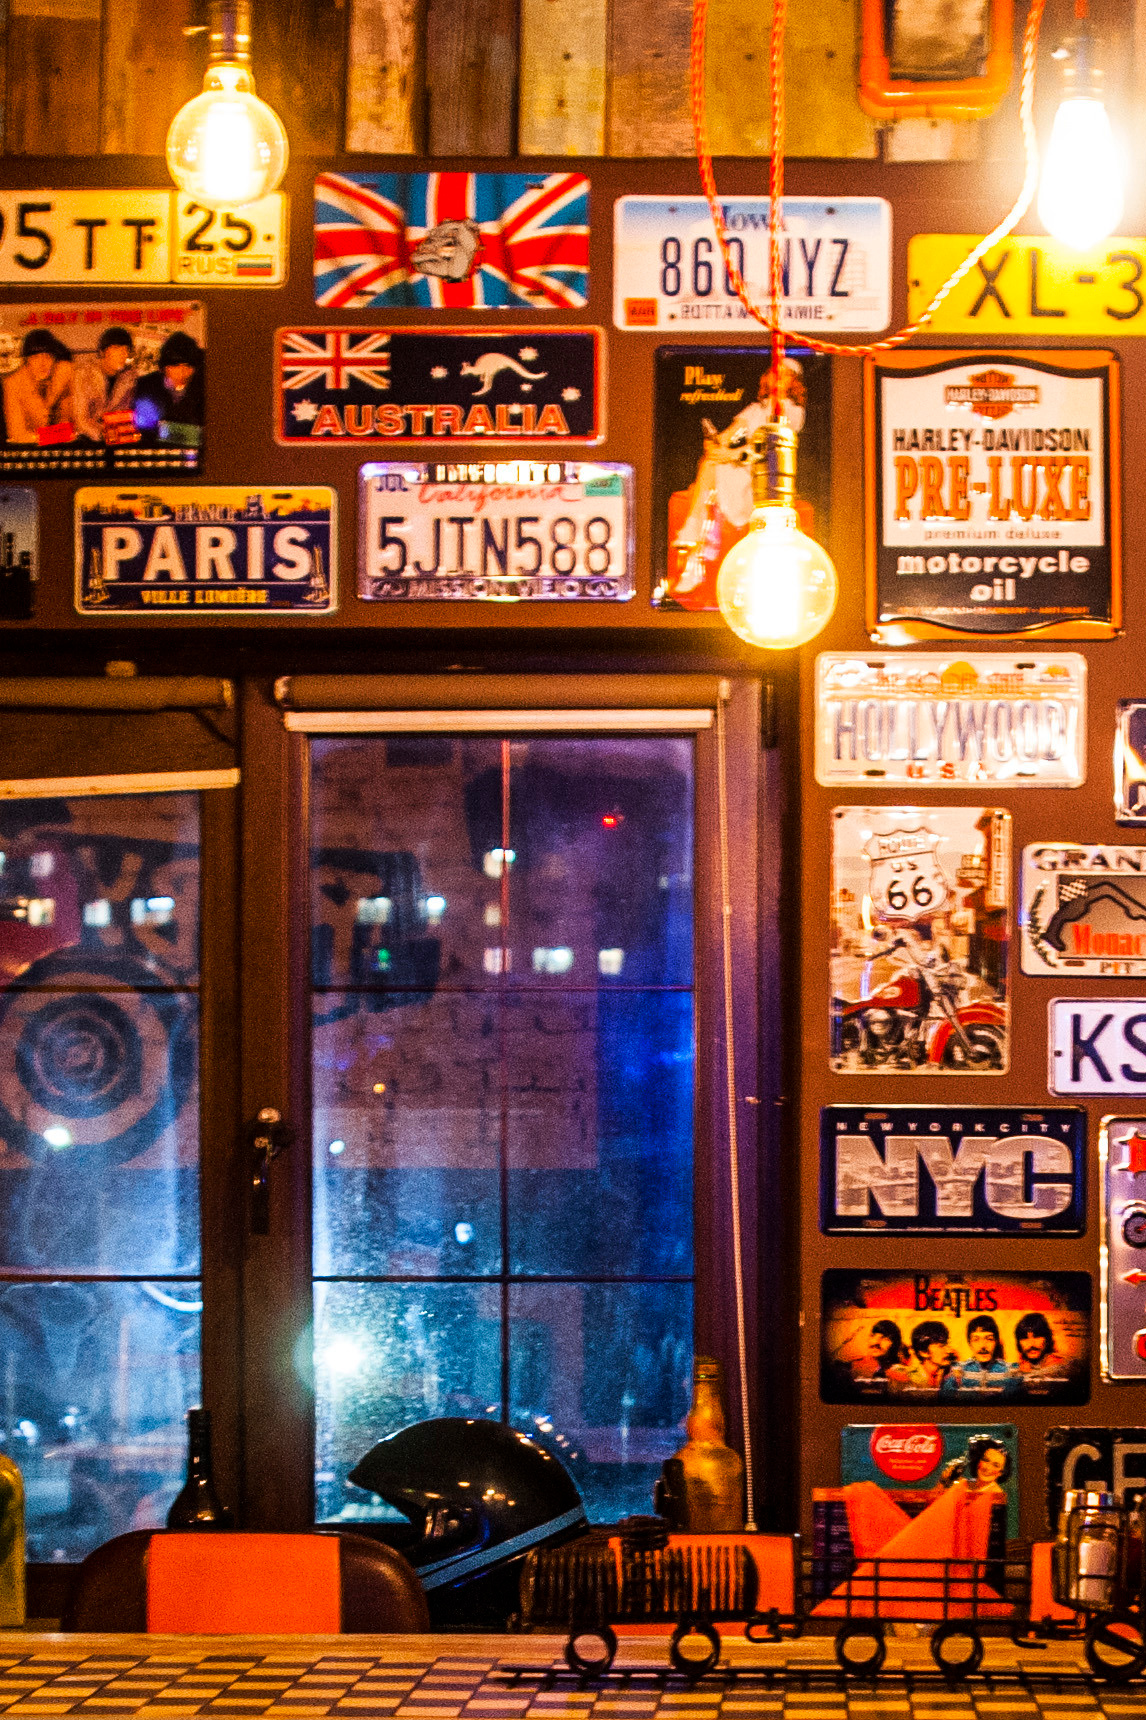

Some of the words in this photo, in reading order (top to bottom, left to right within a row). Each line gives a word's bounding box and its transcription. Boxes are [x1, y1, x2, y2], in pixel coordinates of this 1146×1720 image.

[0, 202, 52, 270] 5
[179, 256, 232, 275] RUS
[684, 366, 725, 390] Play
[310, 403, 571, 436] AUSTRALIA
[892, 428, 1092, 451] HARLEY-DAVIDSON
[417, 482, 582, 512] California
[893, 455, 1091, 522] PRE-LUXE
[378, 516, 612, 577] 5JTN588
[924, 529, 998, 541] premium
[1005, 527, 1062, 540] deluxe
[102, 525, 312, 581] PARIS
[897, 550, 1090, 578] motorcycle
[141, 589, 191, 604] VILLE
[969, 578, 1017, 601] oil
[832, 700, 1070, 762] HOLLYWOOD
[887, 875, 933, 911] 66
[835, 1134, 1074, 1219] NYC
